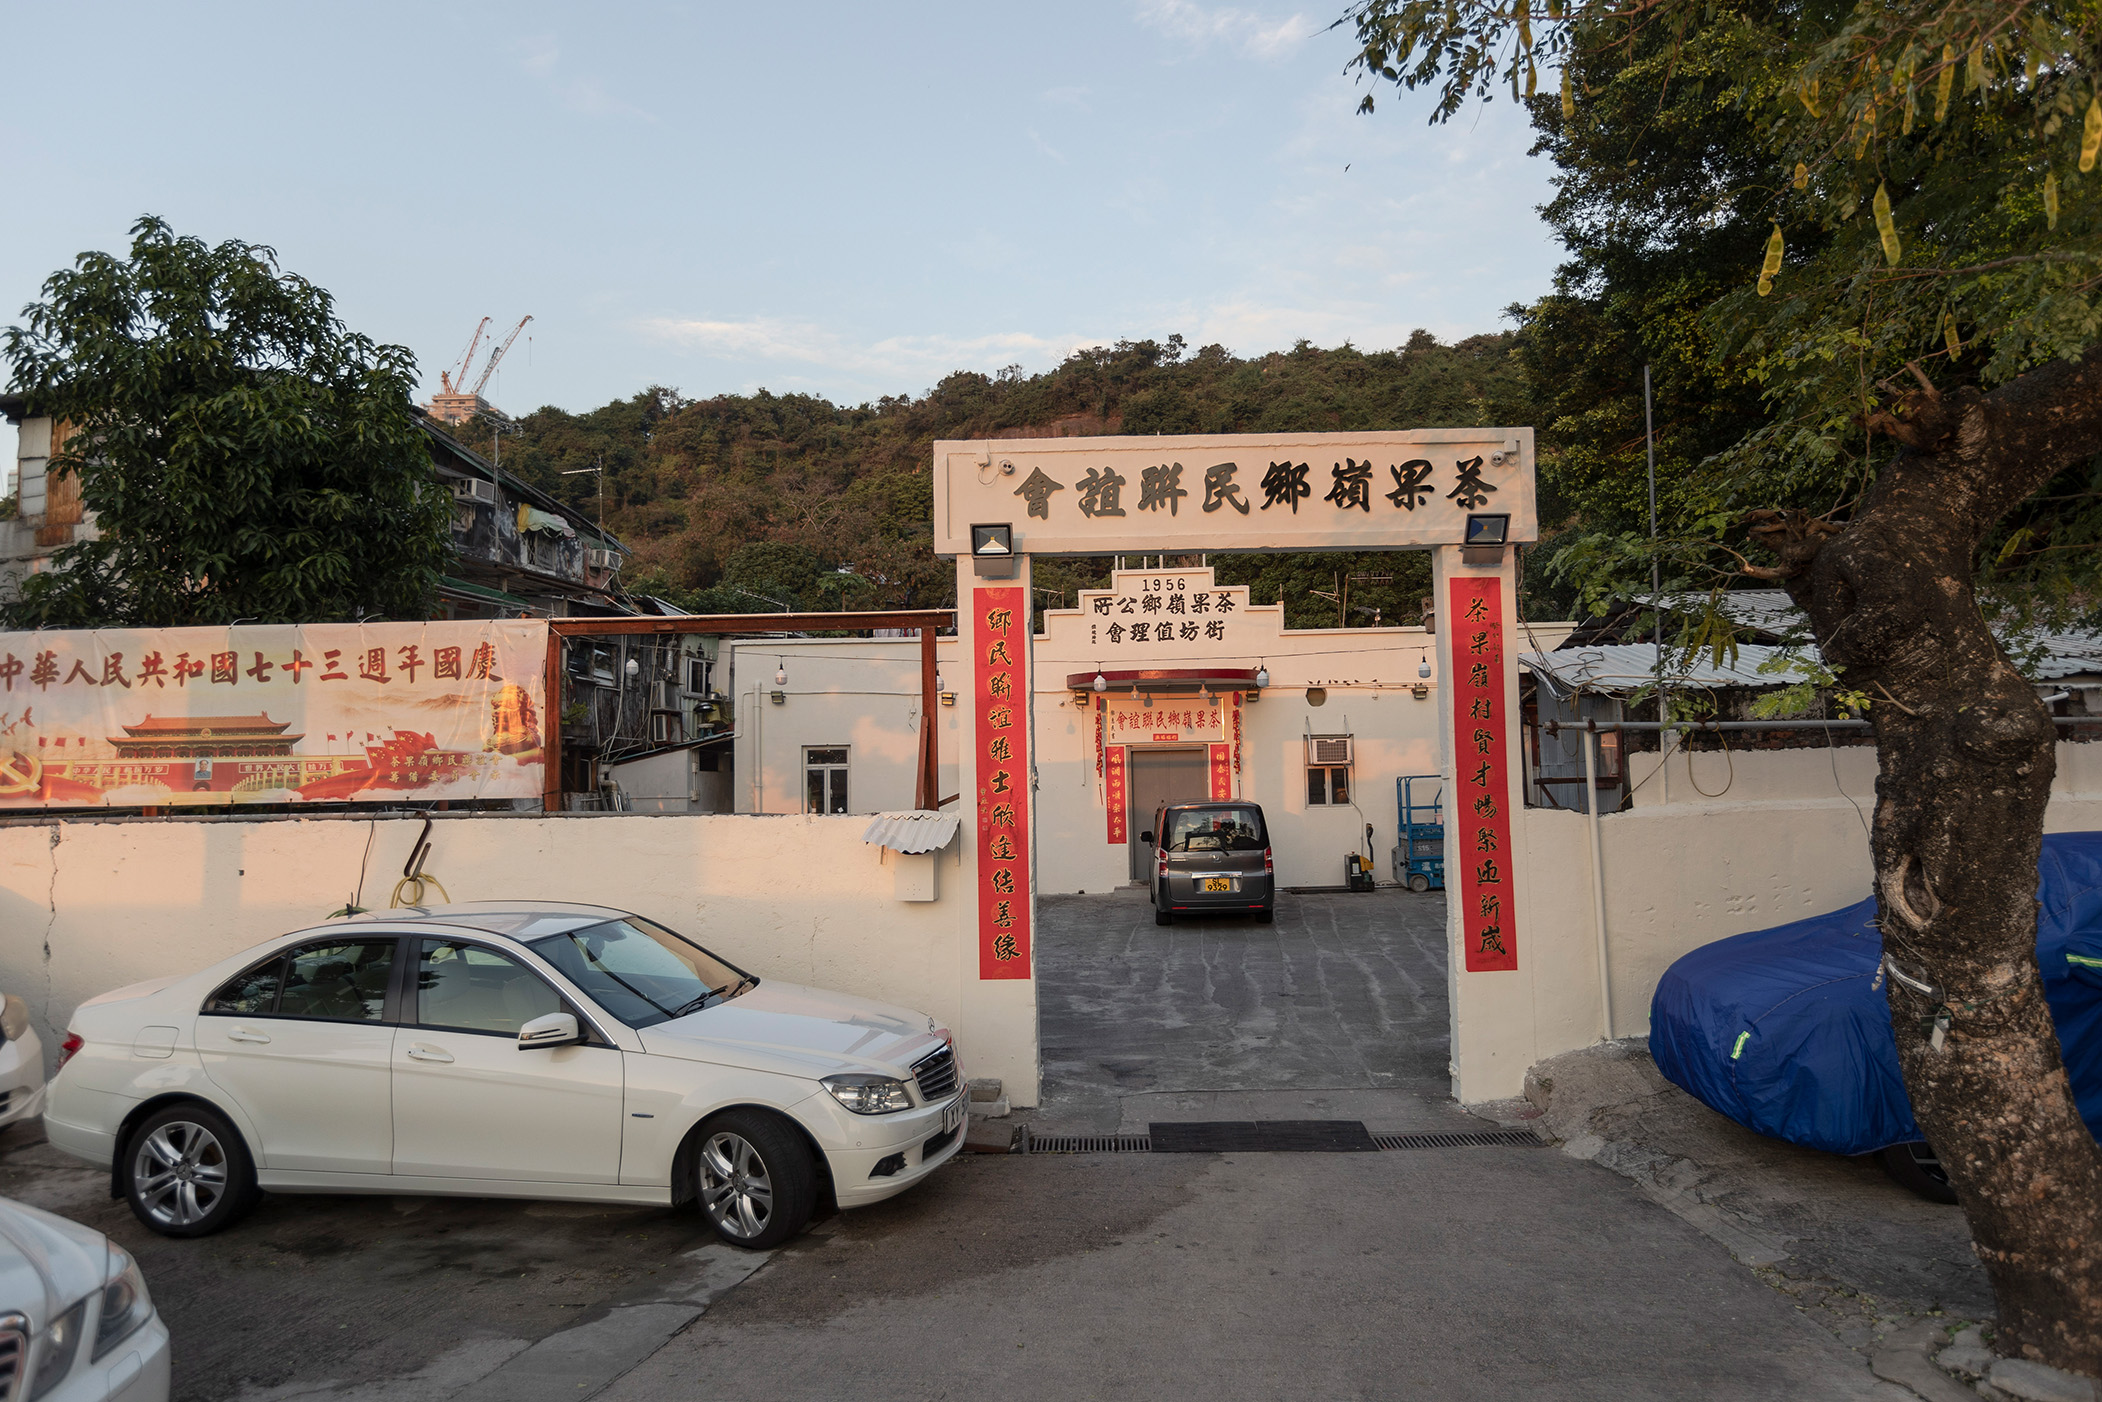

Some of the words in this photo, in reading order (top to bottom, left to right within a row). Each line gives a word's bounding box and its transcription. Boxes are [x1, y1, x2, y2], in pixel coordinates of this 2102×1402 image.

[1013, 455, 1498, 520] 茶果嶺鄉民聯誼會
[1142, 578, 1186, 592] 1956
[1093, 591, 1236, 615] 茶果嶺鄉公所
[1106, 619, 1226, 644] 街坊值理會
